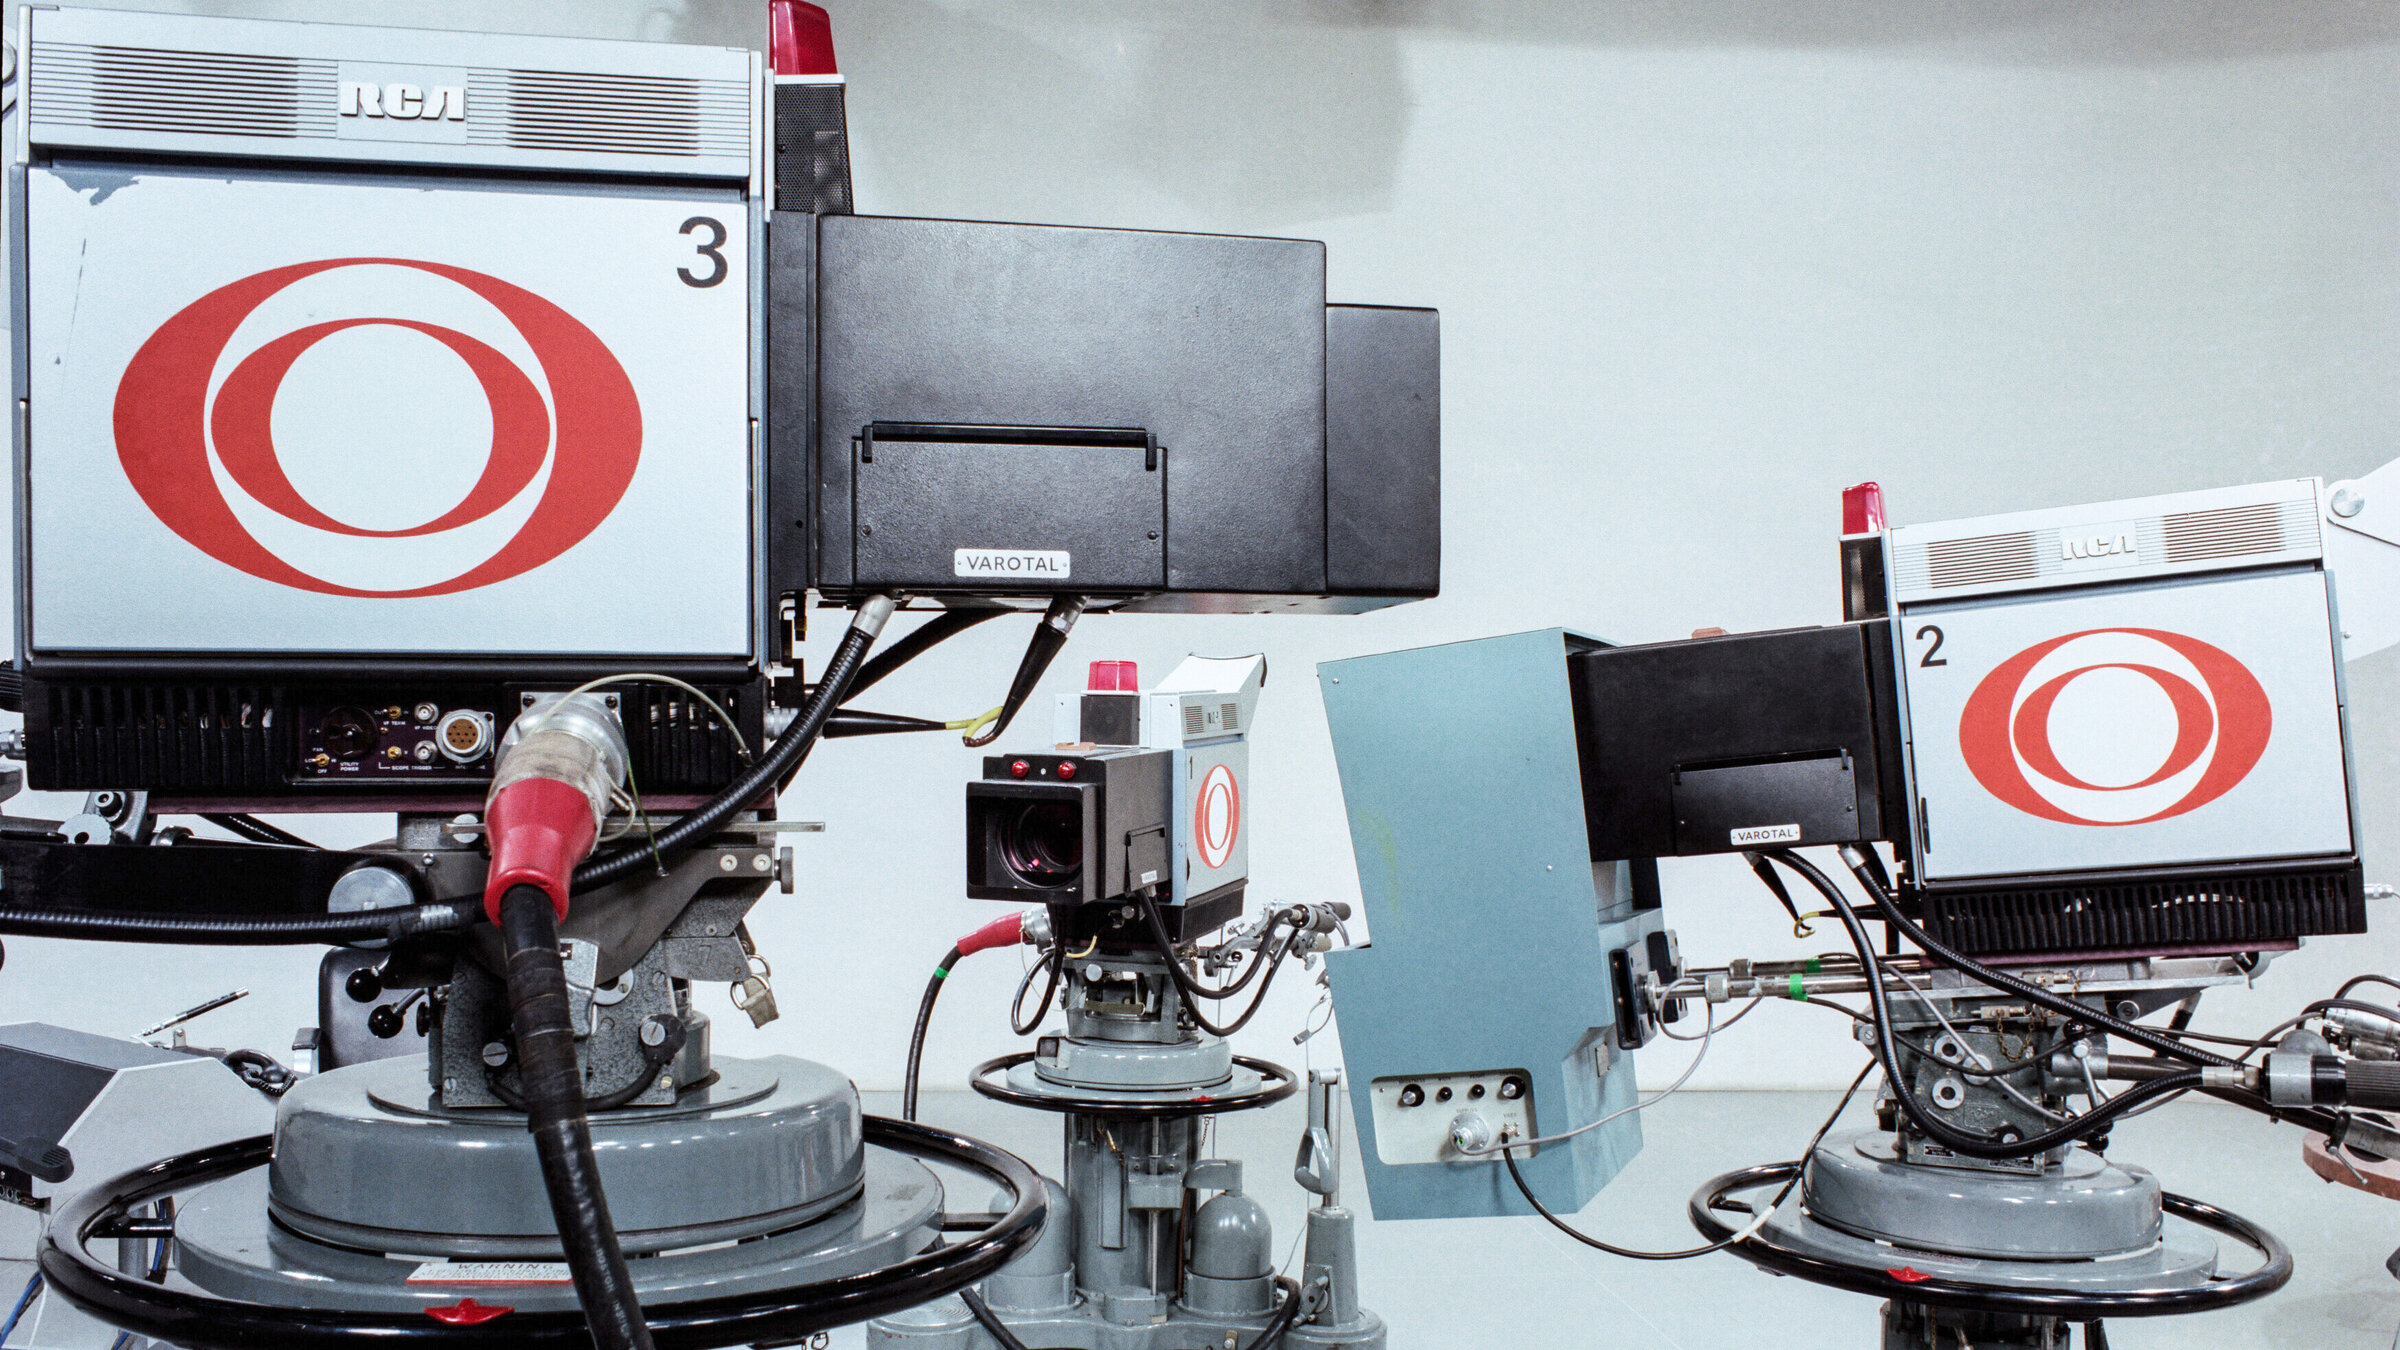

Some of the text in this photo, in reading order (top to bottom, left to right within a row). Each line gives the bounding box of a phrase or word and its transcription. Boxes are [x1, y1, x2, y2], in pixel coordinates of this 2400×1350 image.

[339, 81, 466, 122] RCA
[677, 215, 729, 289] 3
[2060, 532, 2137, 560] RCA
[966, 555, 1059, 572] VAROTAL
[1915, 624, 1948, 668] 2
[1737, 829, 1794, 841] VAROTAL
[458, 1262, 555, 1270] WARNING
